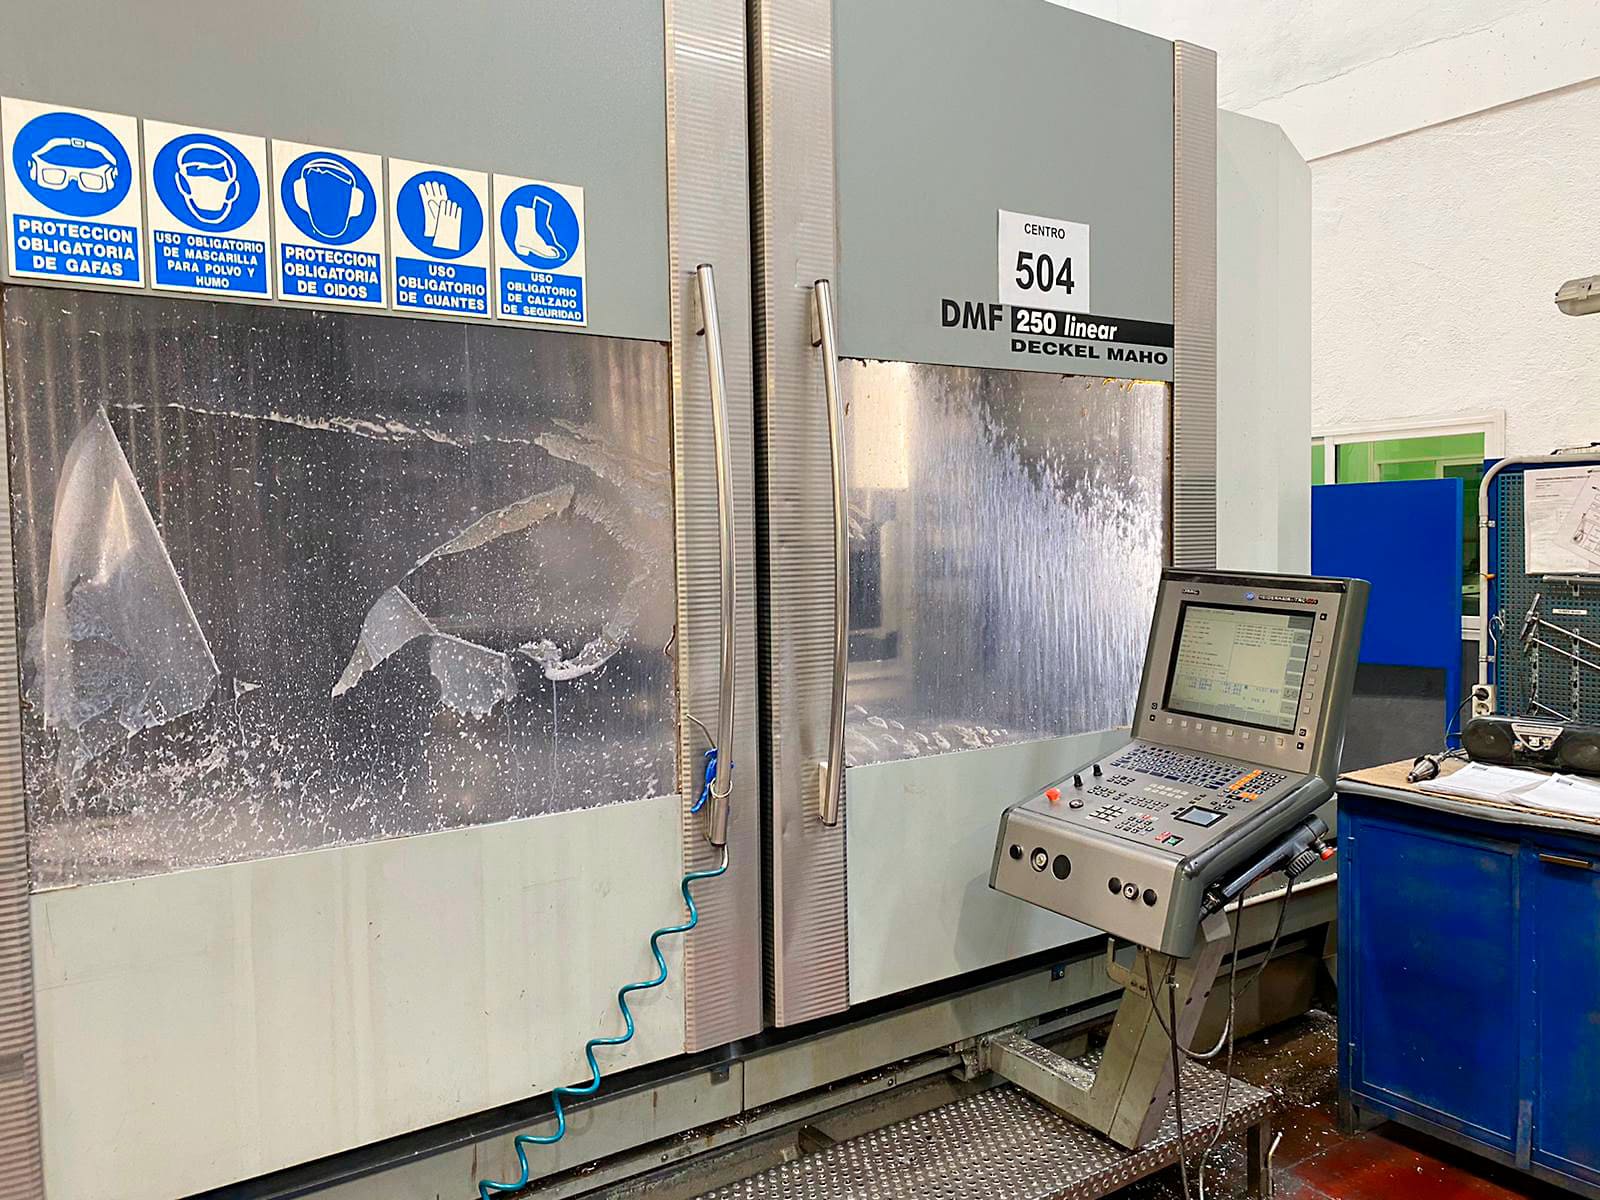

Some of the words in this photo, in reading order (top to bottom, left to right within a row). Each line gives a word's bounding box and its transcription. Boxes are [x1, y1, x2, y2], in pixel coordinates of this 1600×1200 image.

[19, 219, 133, 244] PROTECCION
[1024, 223, 1065, 239] CENTRO
[18, 237, 135, 261] OBLIGATORIA
[156, 232, 181, 245] USO
[187, 236, 263, 253] OBLIGATORIO
[163, 246, 179, 258] DE
[185, 249, 258, 265] MASCARILLA
[285, 248, 376, 267] PROTECCION
[33, 256, 56, 270] DE
[66, 259, 123, 276] GAFAS
[168, 260, 199, 273] PARA
[205, 264, 241, 276] POLVO
[247, 267, 255, 278] Y
[284, 263, 379, 284] OBLIGATORIA
[429, 265, 455, 278] USO
[1015, 250, 1075, 295] 504
[196, 276, 229, 288] HUMO
[398, 276, 485, 296] OBLIGATORIO
[531, 273, 553, 283] USO
[297, 280, 317, 294] DE
[324, 283, 368, 298] OIDOS
[507, 282, 577, 297] OBLIGATORIO
[399, 291, 417, 304] DE
[424, 294, 485, 310] GUANTES
[507, 294, 521, 304] DE
[528, 296, 577, 308] CALZADO
[503, 304, 517, 314] DE
[523, 306, 581, 320] SEGURIDAD
[941, 299, 1003, 331] DMF
[1017, 310, 1056, 334] 250
[1063, 314, 1118, 340] linear
[1011, 339, 1099, 359] DECKEL
[1108, 348, 1168, 364] MAHO
